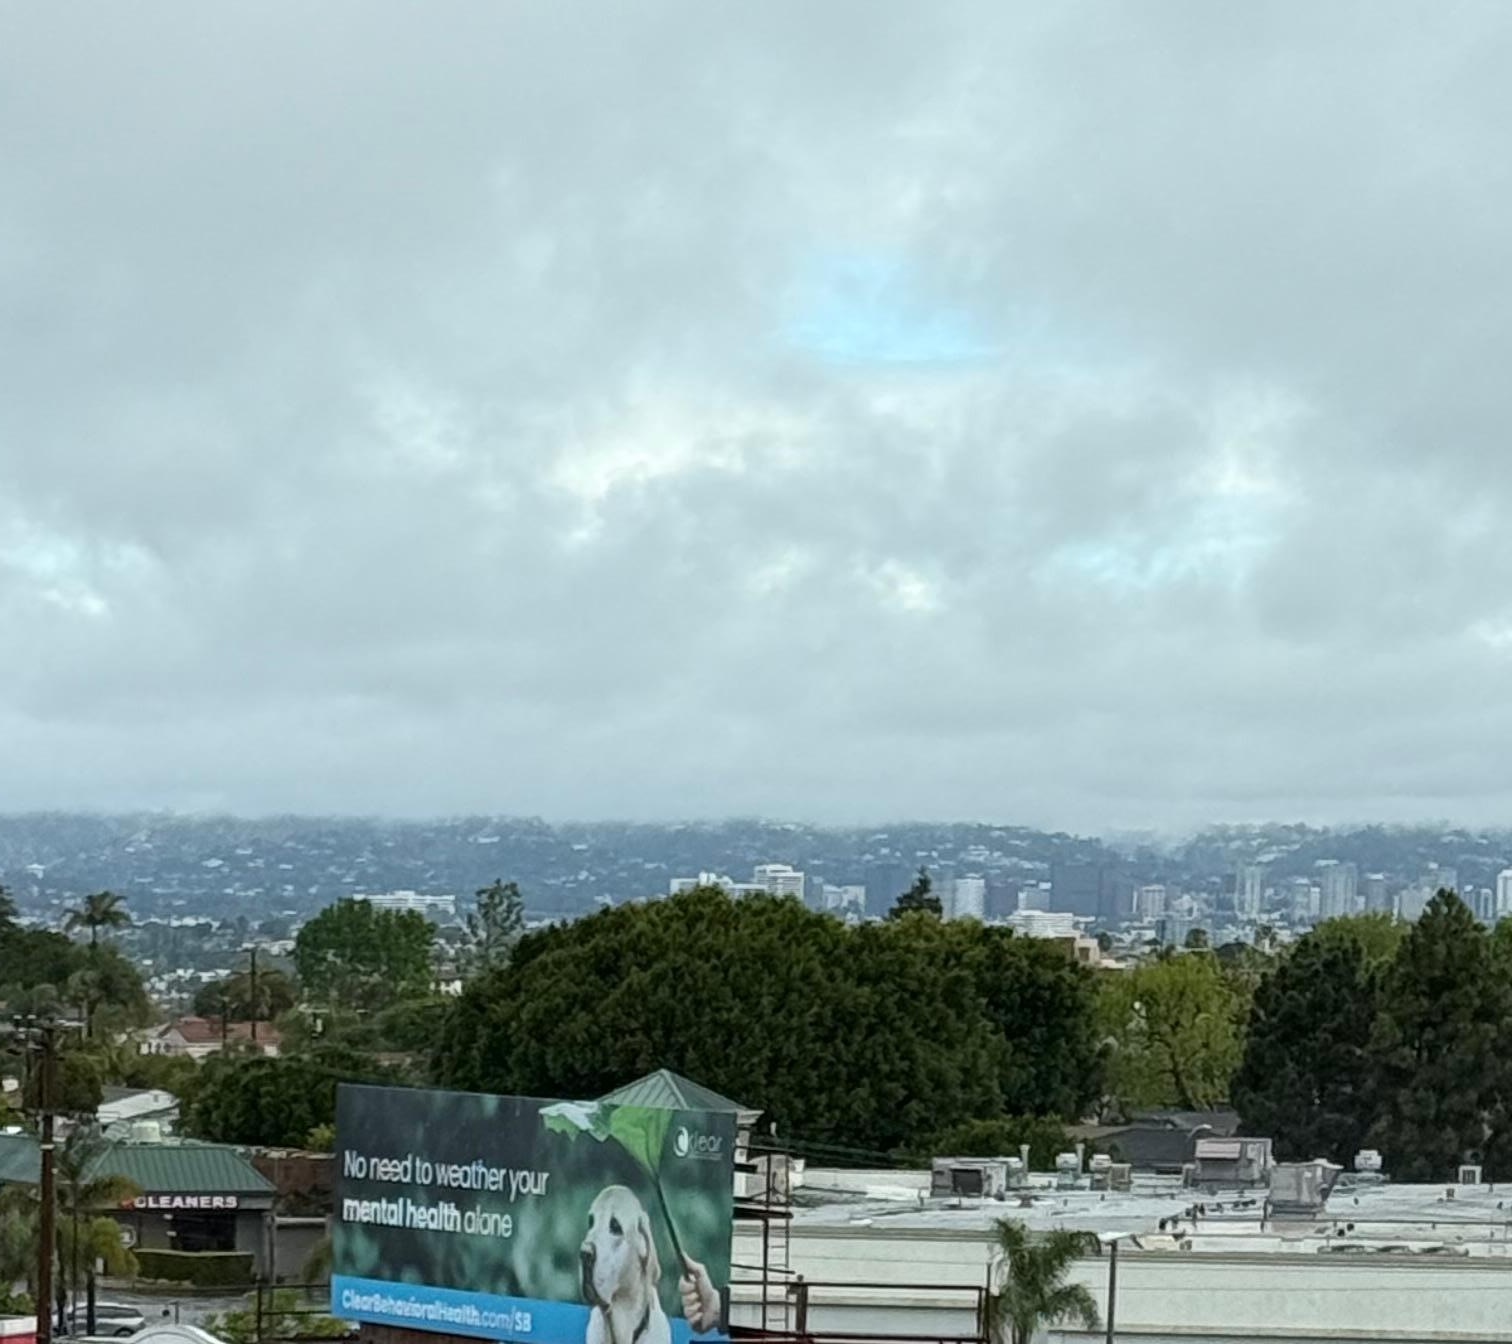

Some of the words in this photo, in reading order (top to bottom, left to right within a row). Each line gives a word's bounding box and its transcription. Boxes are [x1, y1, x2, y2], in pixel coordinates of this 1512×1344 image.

[344, 1150, 367, 1179] No
[369, 1153, 413, 1184] need
[415, 1156, 433, 1185] to
[435, 1159, 507, 1191] weather
[509, 1168, 550, 1203] your
[134, 1196, 238, 1209] CLEANERS
[343, 1197, 404, 1227] mental
[405, 1198, 462, 1233] health
[464, 1204, 513, 1239] alone
[342, 1289, 532, 1336] ClearBehavioralHealth.com/SB
